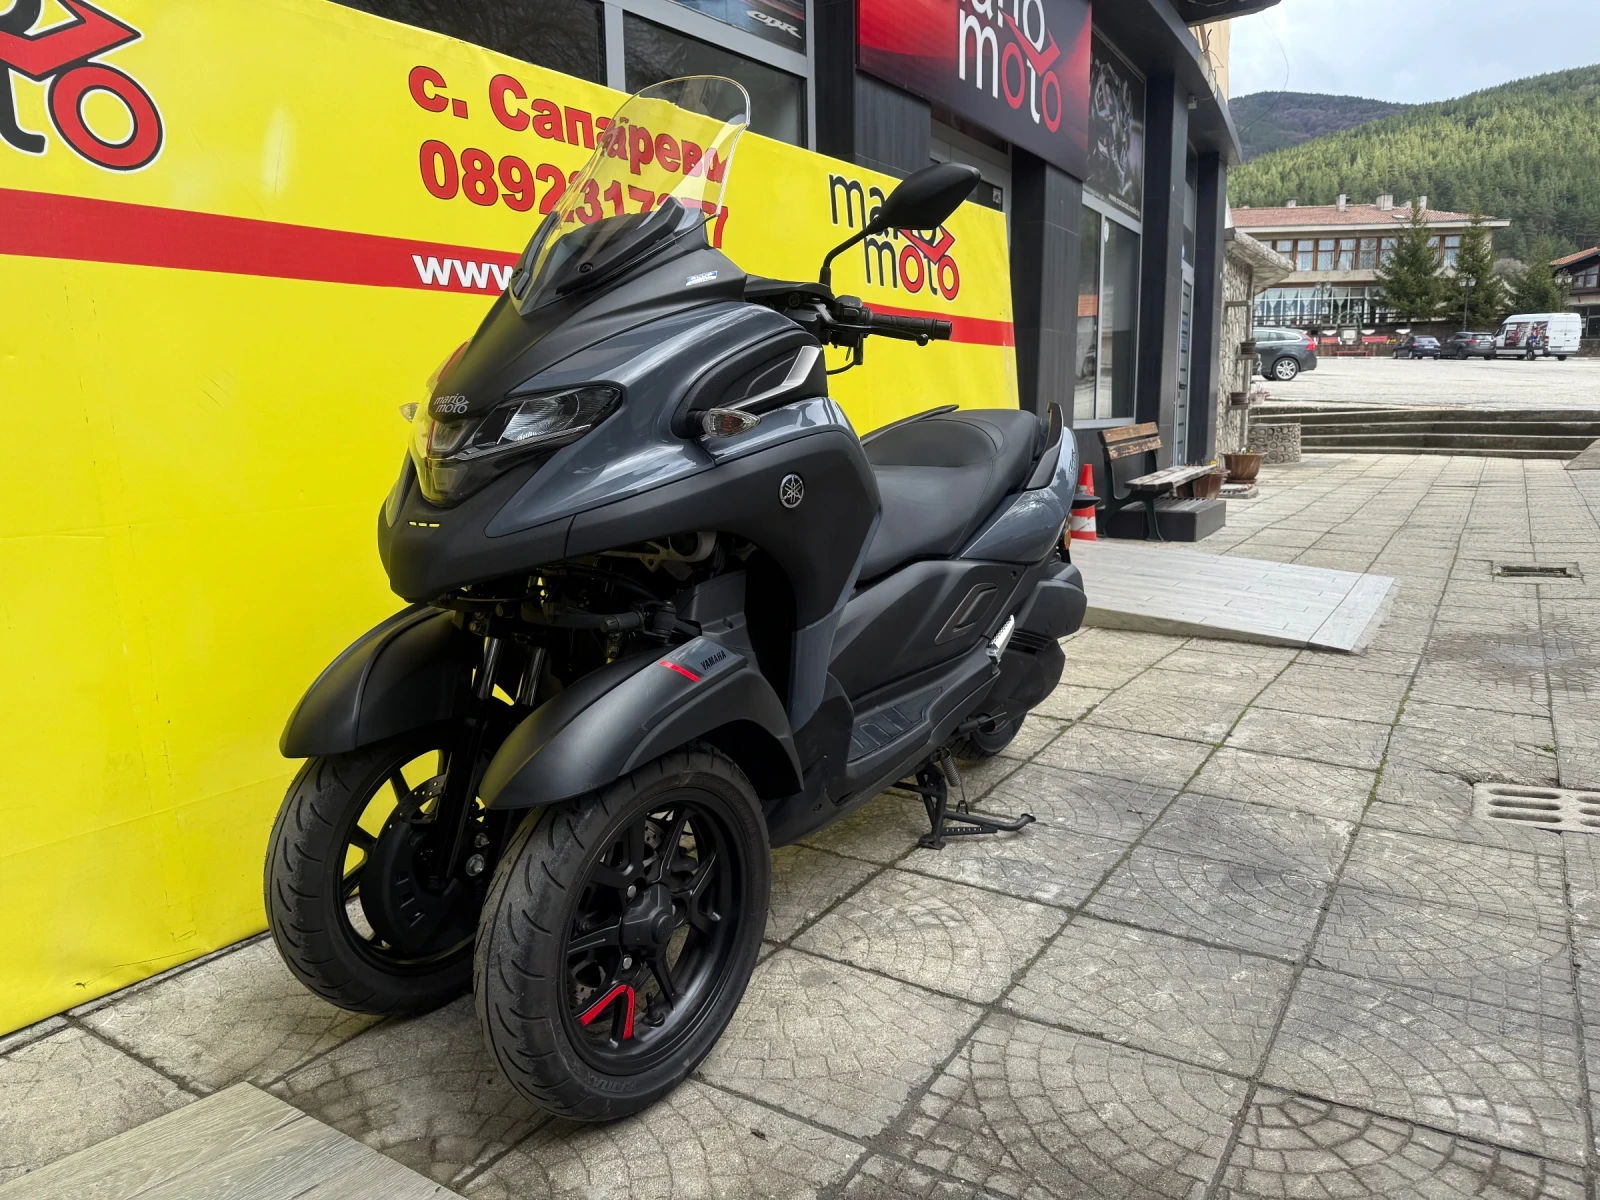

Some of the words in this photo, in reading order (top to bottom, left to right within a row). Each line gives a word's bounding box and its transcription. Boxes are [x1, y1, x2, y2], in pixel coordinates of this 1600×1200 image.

[746, 10, 803, 39] CBR
[958, 8, 1063, 133] moto
[419, 140, 729, 249] 08923177
[865, 234, 961, 302] moto
[435, 393, 467, 404] mario
[435, 403, 468, 413] moto
[700, 649, 727, 670] YAMAHA
